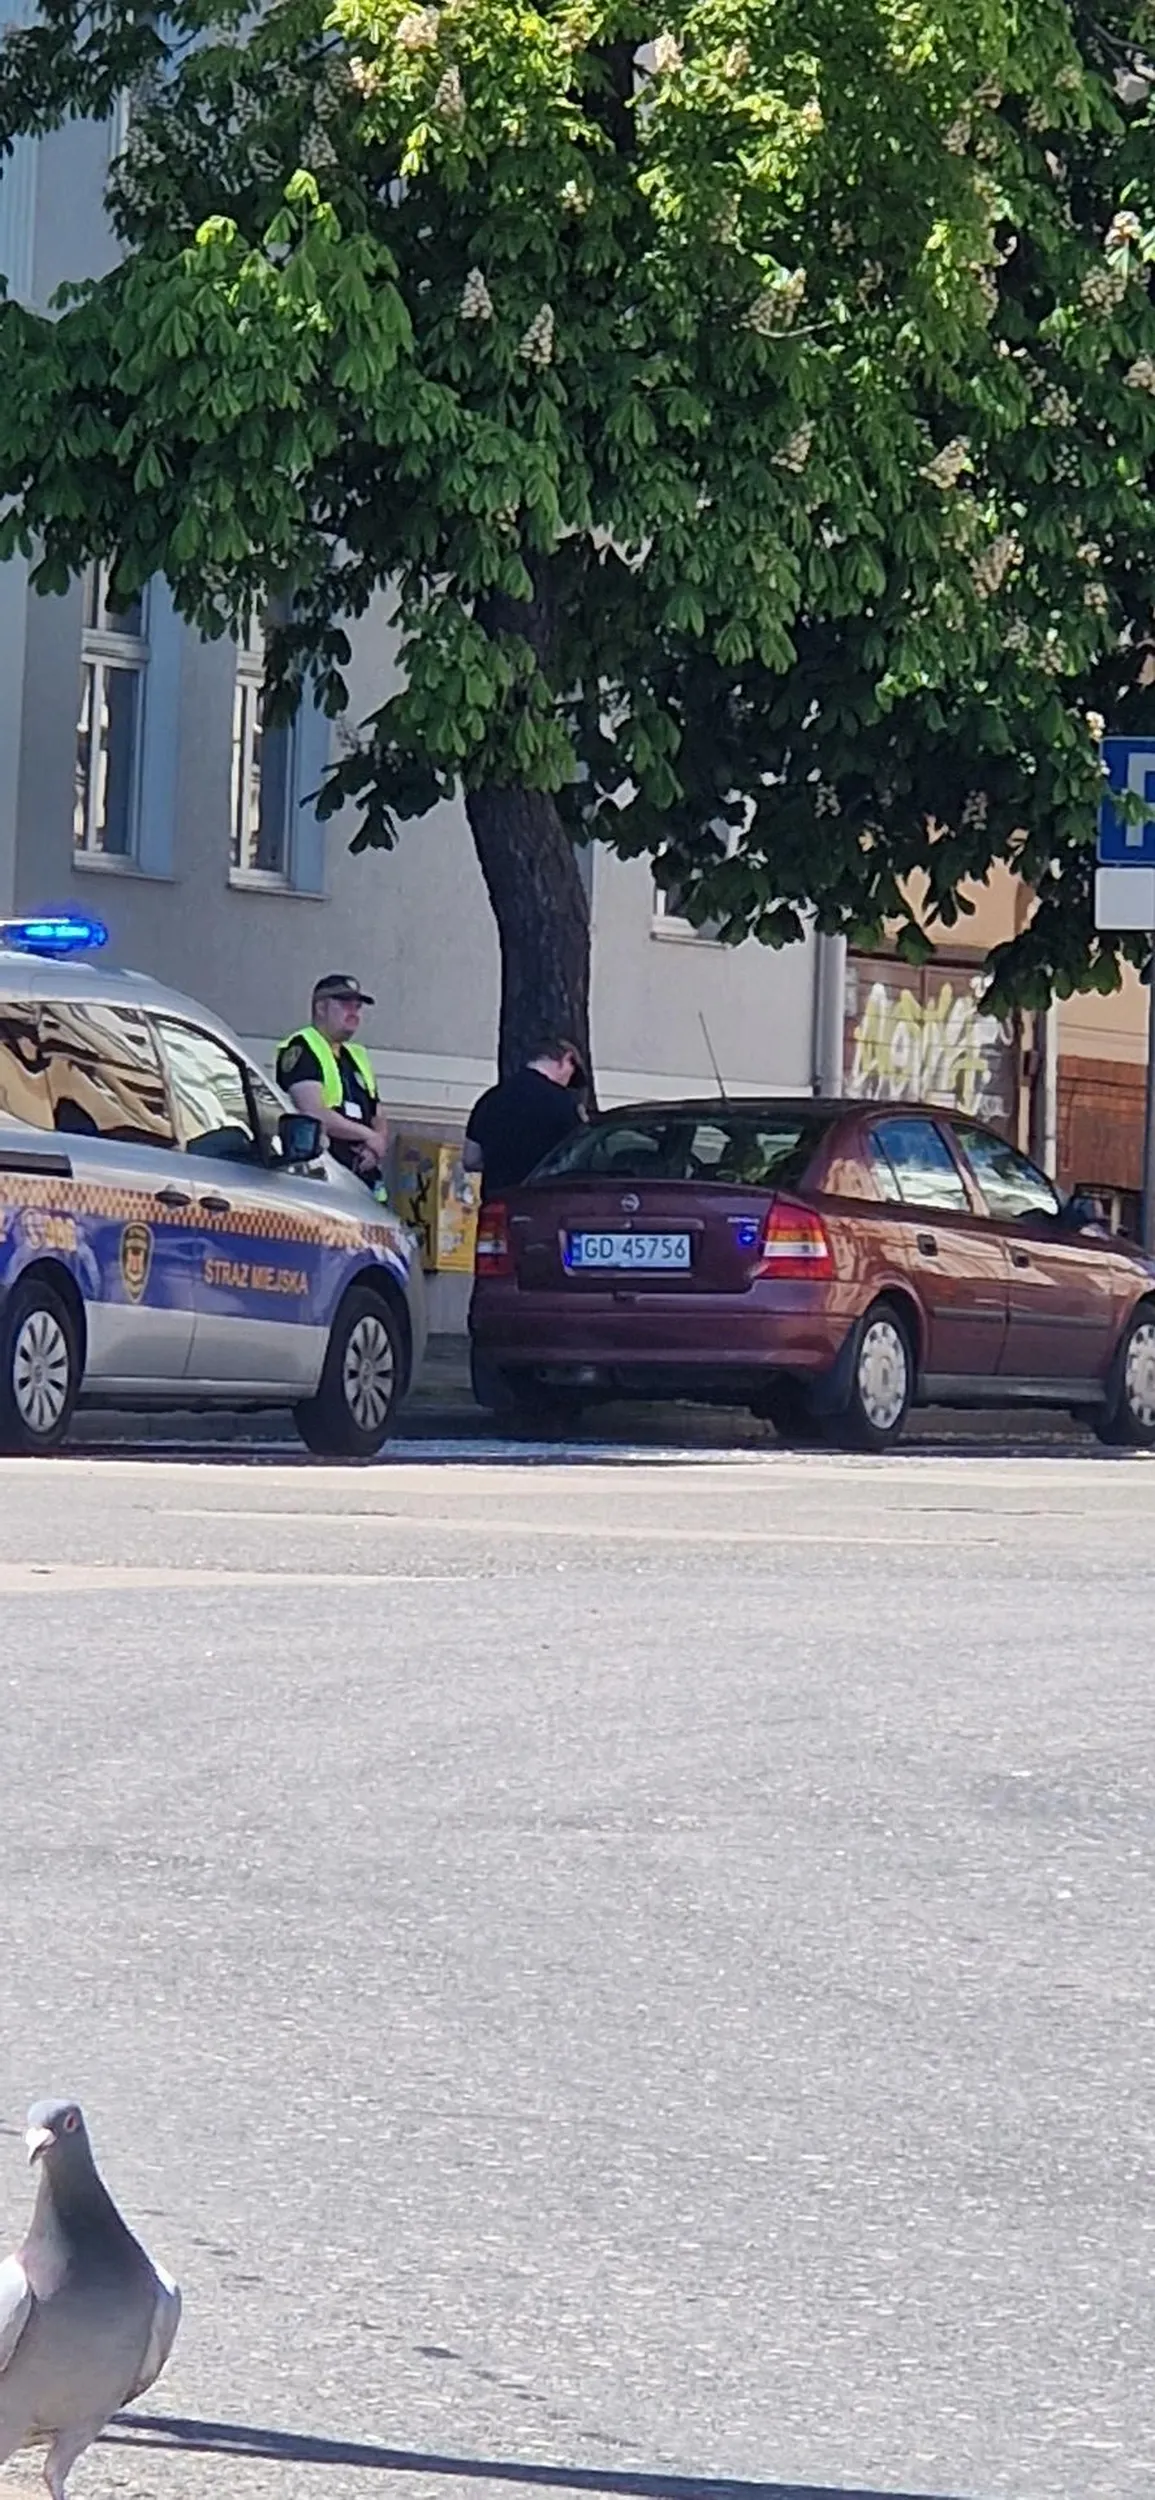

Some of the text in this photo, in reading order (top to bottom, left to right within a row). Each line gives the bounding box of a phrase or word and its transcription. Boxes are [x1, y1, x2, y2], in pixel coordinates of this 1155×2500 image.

[585, 1237, 614, 1259] GD
[621, 1237, 686, 1259] 45756
[251, 1264, 309, 1295] MIEJSKA
